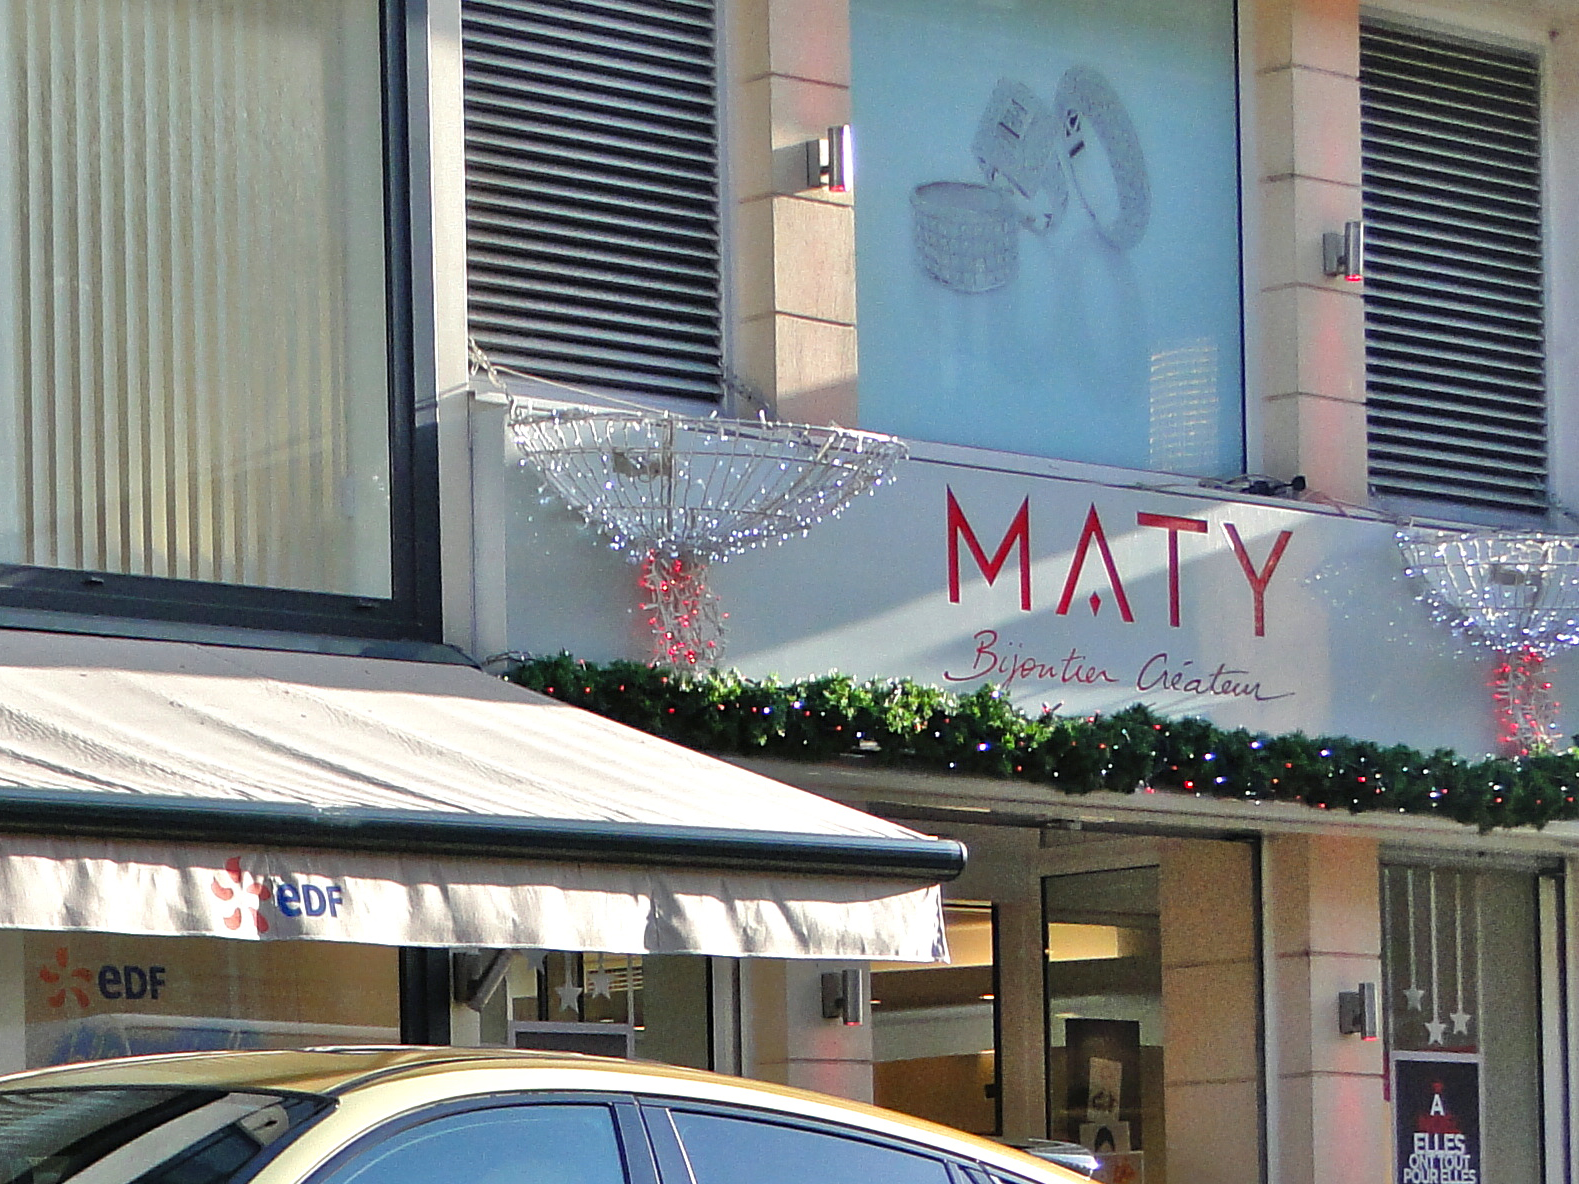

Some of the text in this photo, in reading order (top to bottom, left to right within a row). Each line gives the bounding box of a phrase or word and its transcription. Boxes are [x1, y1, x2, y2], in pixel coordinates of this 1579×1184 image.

[945, 483, 1294, 637] MATY
[943, 629, 1296, 701] Bijoutier Créateur
[1430, 1093, 1445, 1116] A
[1413, 1132, 1467, 1154] ELLES
[1408, 1153, 1472, 1171] ONT TOUT
[1403, 1167, 1439, 1184] POUR
